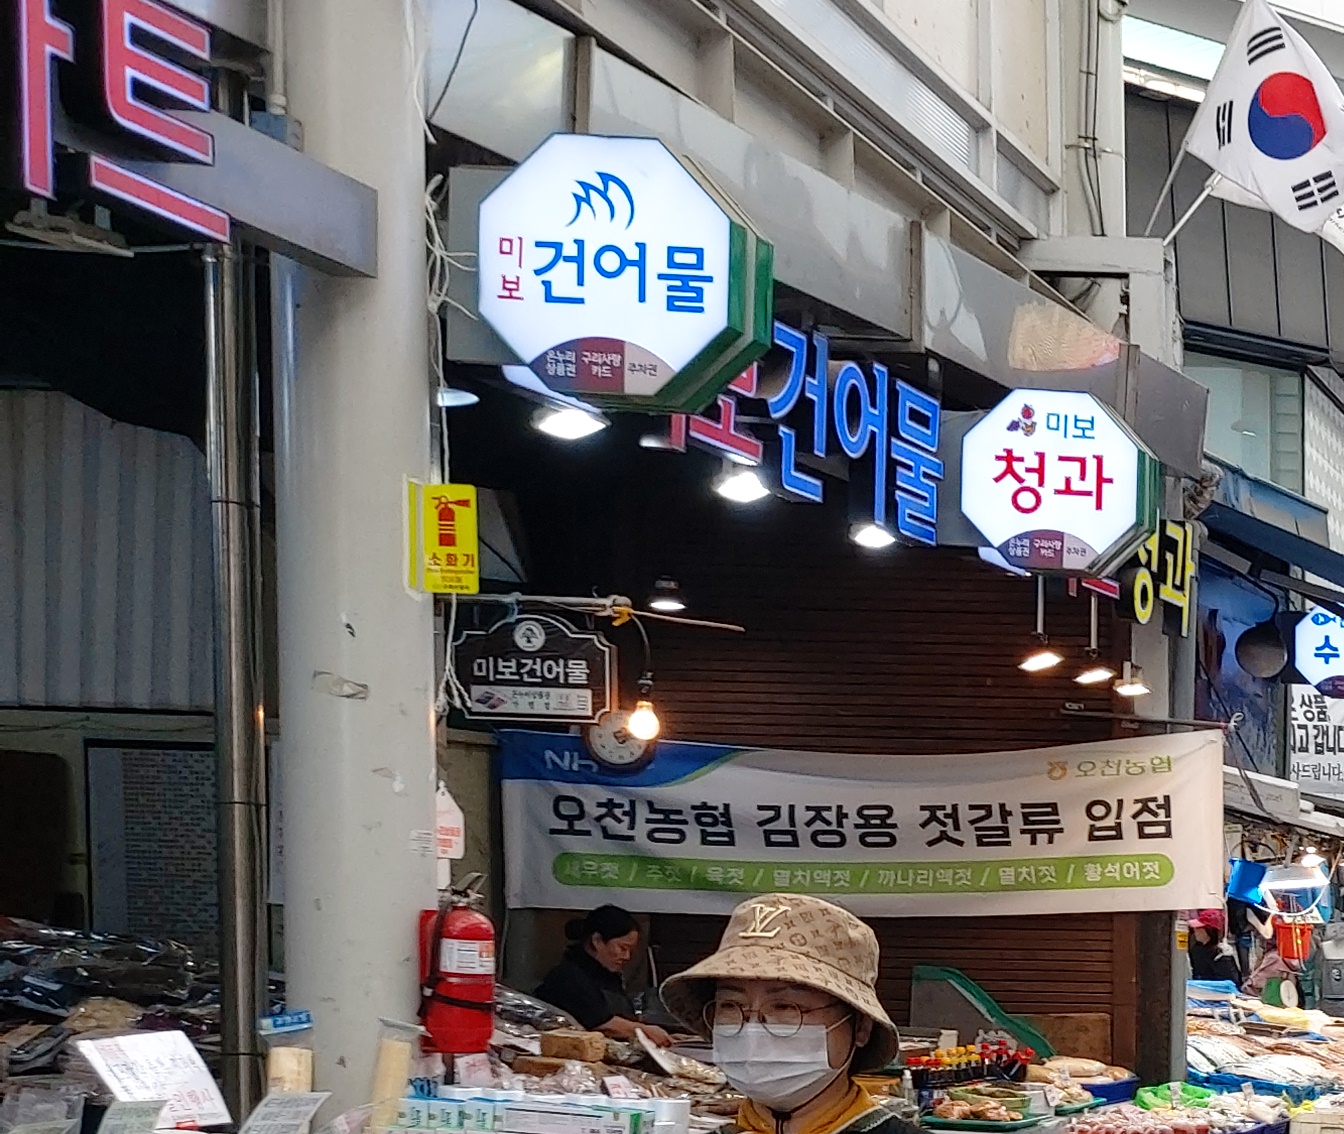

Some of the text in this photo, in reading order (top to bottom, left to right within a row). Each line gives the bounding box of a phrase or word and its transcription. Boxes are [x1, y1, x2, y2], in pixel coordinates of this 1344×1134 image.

[533, 238, 714, 314] 건어물
[1046, 411, 1096, 440] 미보
[992, 447, 1115, 515] 청과
[428, 551, 475, 568] 소화기
[472, 655, 591, 685] 미보건어물
[1075, 755, 1174, 780] 오천농협
[548, 793, 1175, 851] 오천농협 김장용 젓갈류 입점
[771, 867, 851, 889] 멸치액젓
[876, 863, 974, 889] 까나리액젓
[997, 862, 1058, 886] 멸치젓
[1082, 857, 1161, 883] 황석어젓
